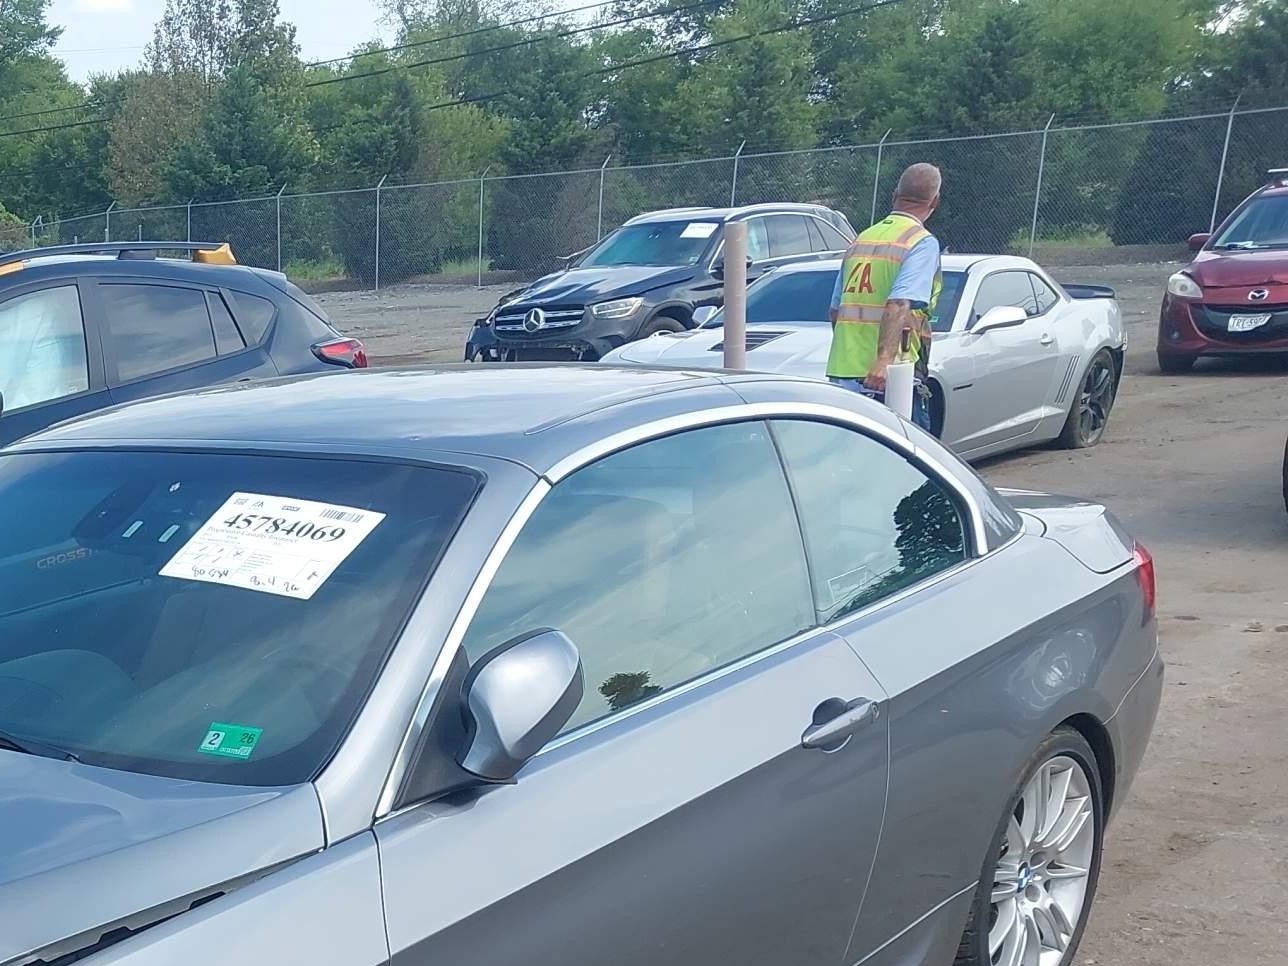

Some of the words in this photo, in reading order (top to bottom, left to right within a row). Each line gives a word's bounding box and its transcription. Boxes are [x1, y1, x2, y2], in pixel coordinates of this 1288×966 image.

[223, 512, 346, 543] 45784069
[208, 732, 221, 746] 2
[240, 732, 256, 745] 26
